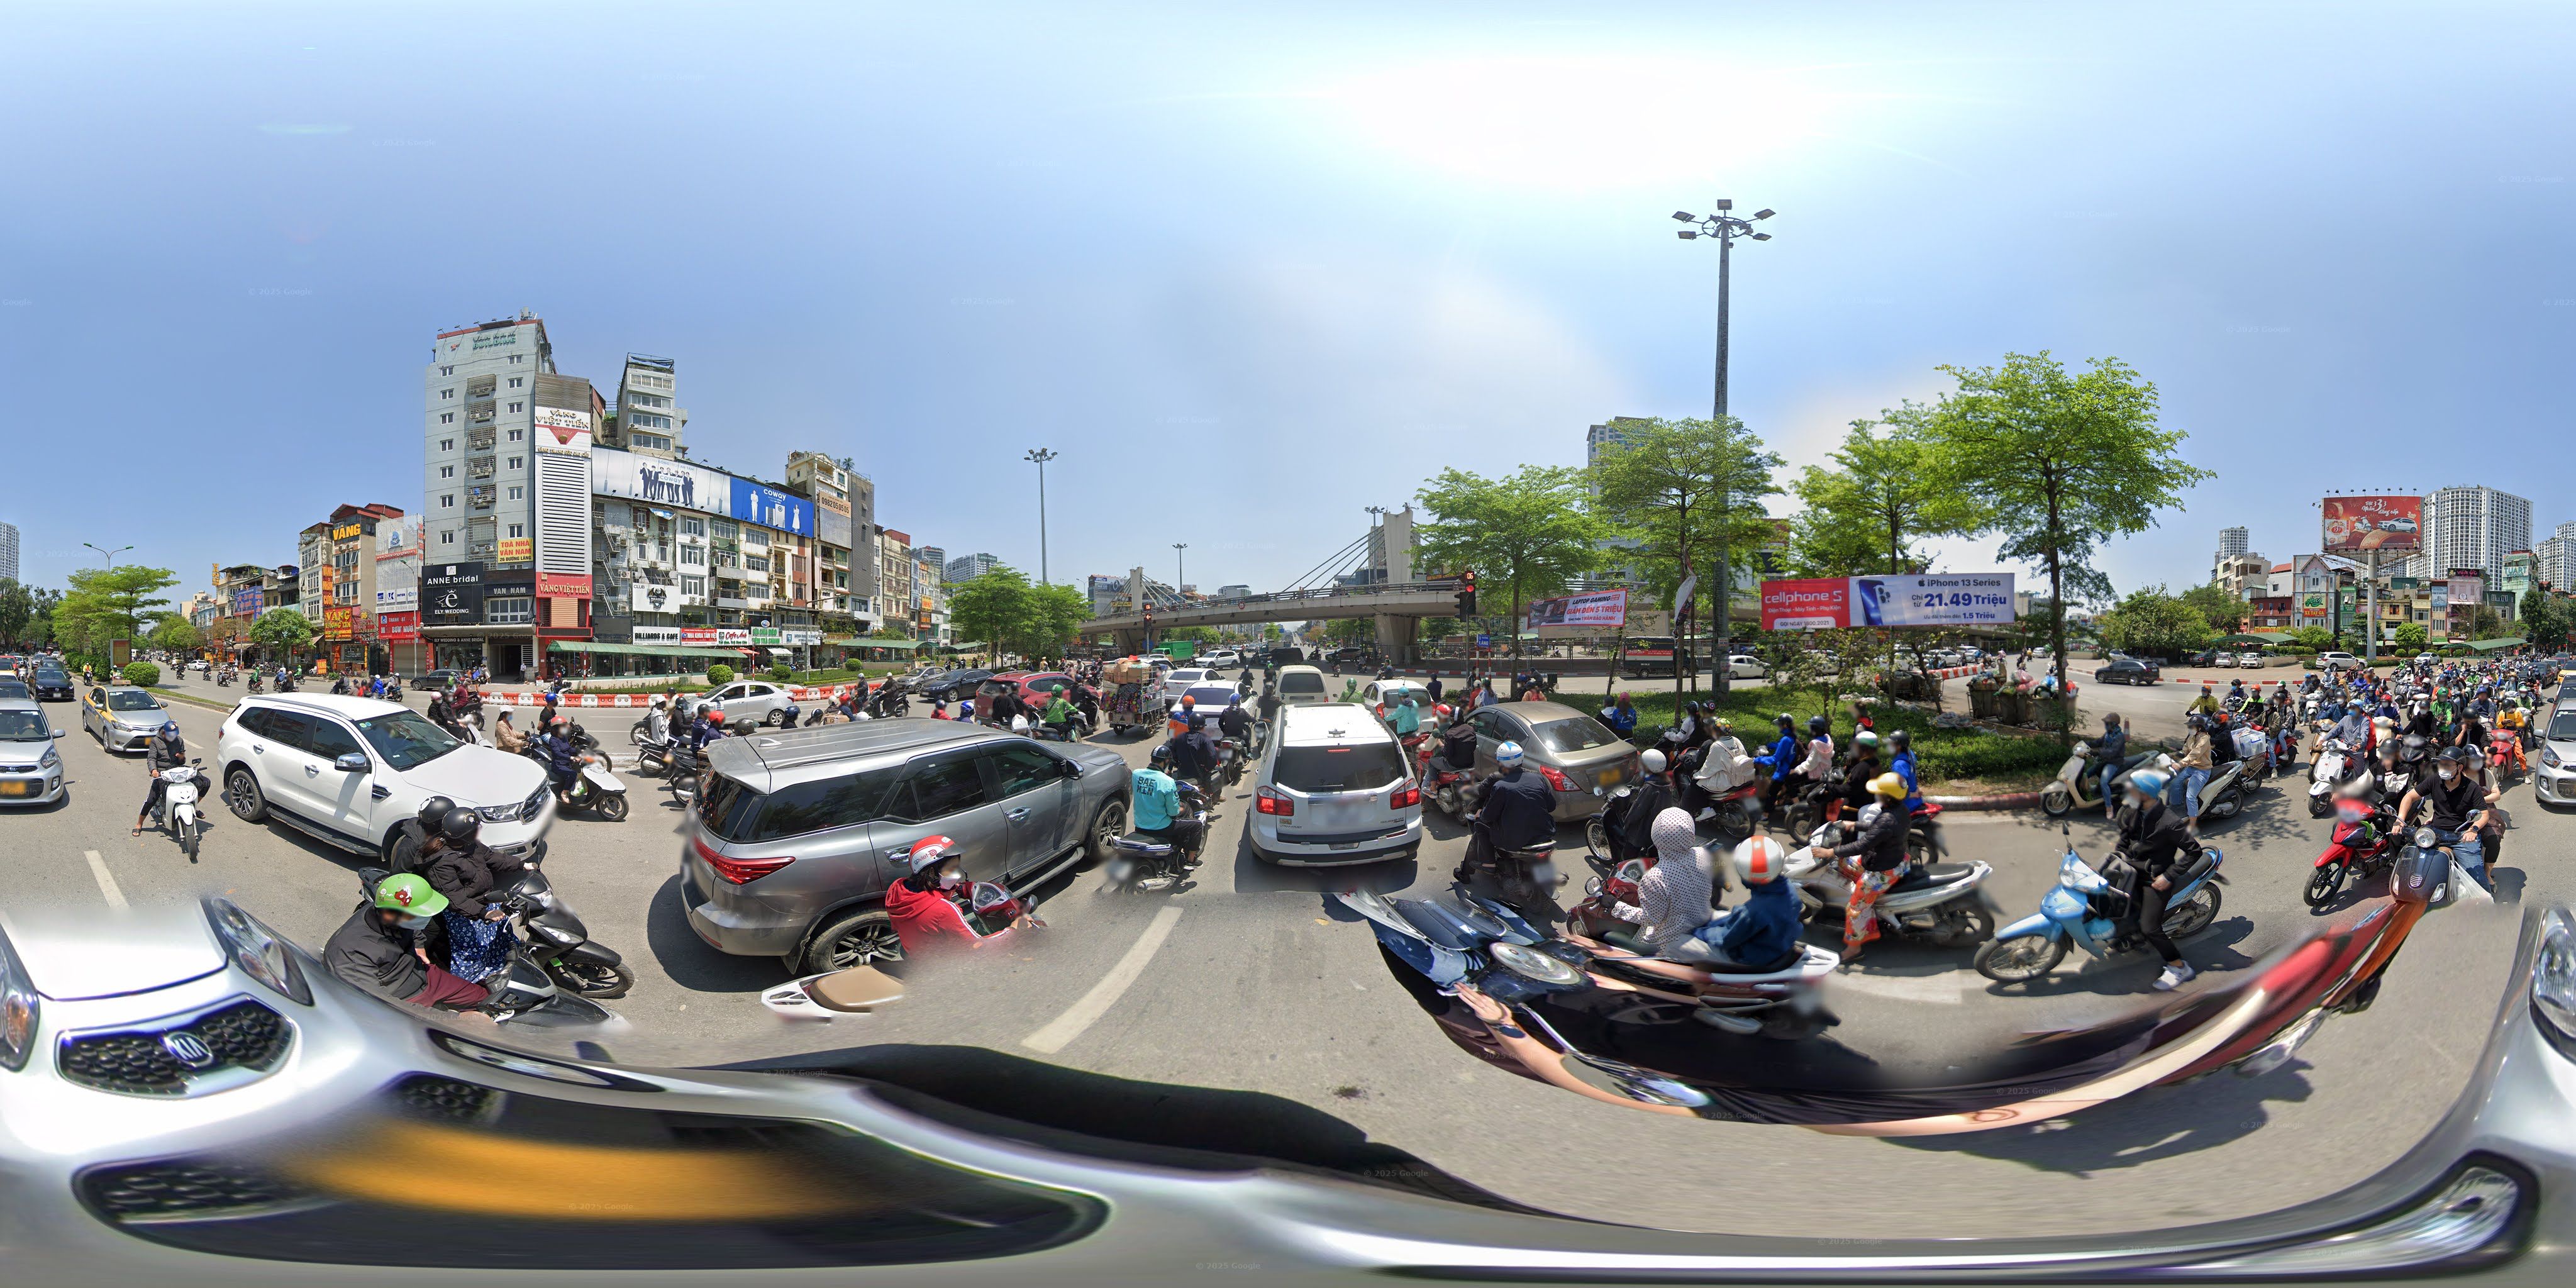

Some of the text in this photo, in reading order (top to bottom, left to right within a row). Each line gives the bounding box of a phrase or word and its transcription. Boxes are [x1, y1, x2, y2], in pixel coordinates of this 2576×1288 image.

[333, 523, 361, 541] VÀNG
[515, 539, 530, 547] NHÀ
[427, 575, 479, 585] ANNE bridal
[1928, 579, 1959, 587] iPhone
[540, 582, 590, 595] VÀNG VIỆT TIẾN
[1924, 593, 2007, 607] 21.49 Triệu
[1567, 606, 1580, 615] GIẢM
[1582, 604, 1595, 614] ĐẾN
[1602, 604, 1623, 615] TRIỆU
[1975, 612, 1995, 620] Triệu
[1138, 776, 1156, 787] BAE
[1137, 785, 1153, 796] MIN
[165, 1036, 209, 1061] KIA
